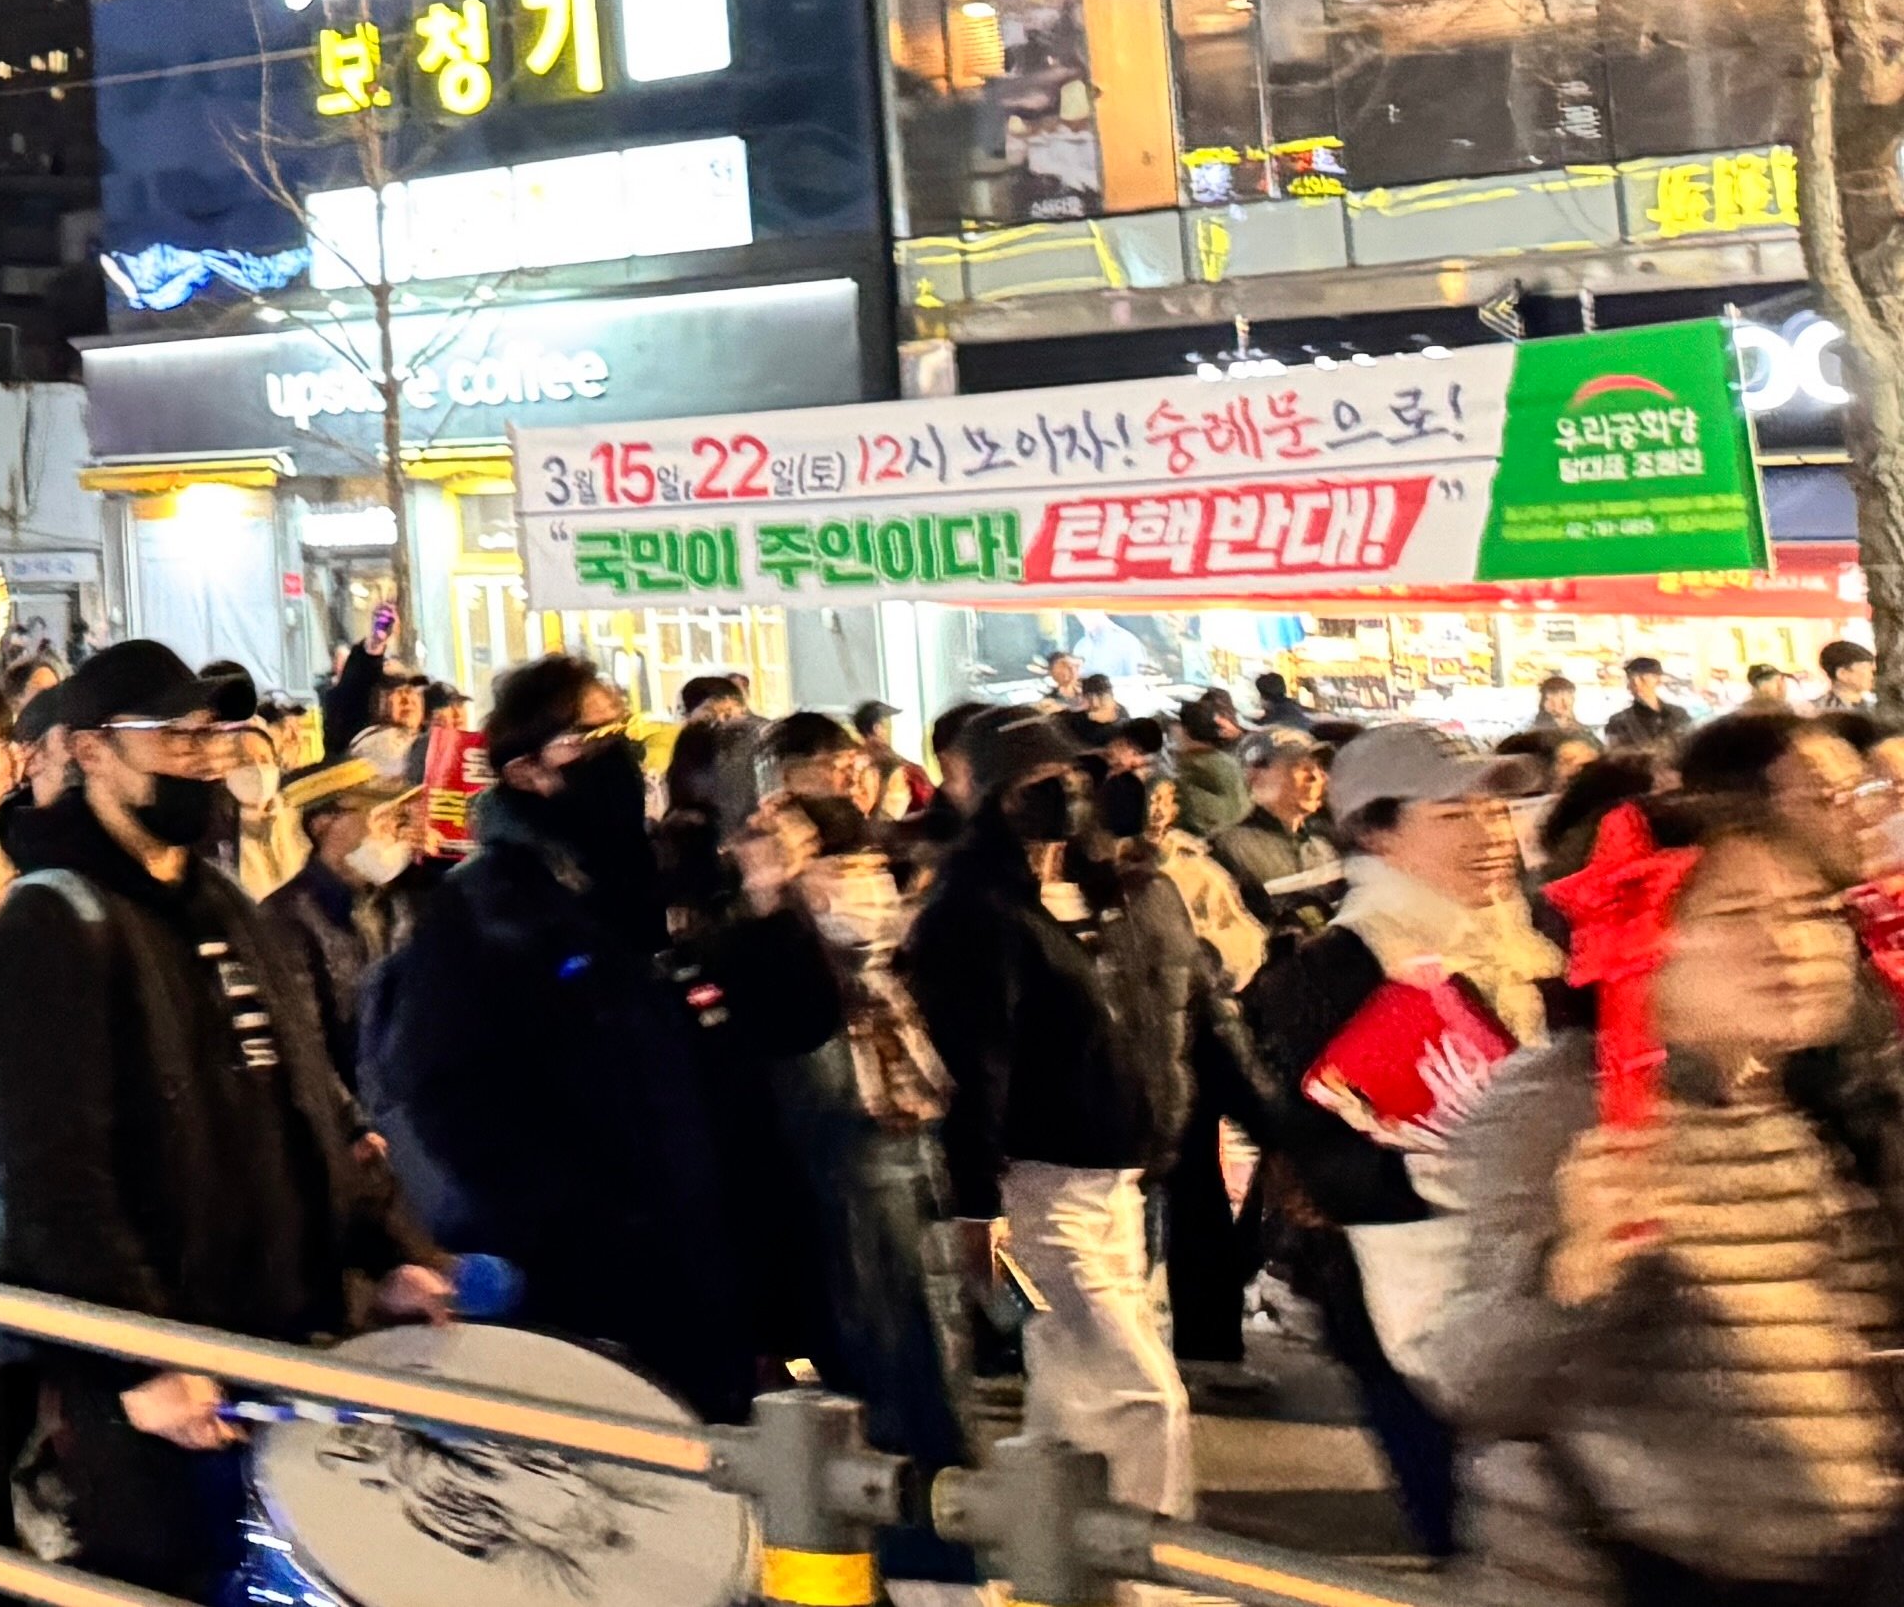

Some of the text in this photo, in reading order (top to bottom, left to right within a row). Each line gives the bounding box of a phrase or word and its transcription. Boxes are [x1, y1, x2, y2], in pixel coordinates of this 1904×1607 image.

[447, 343, 609, 407] coffee
[963, 408, 1134, 477] 모이자!
[1554, 407, 1700, 452] 우리공화당
